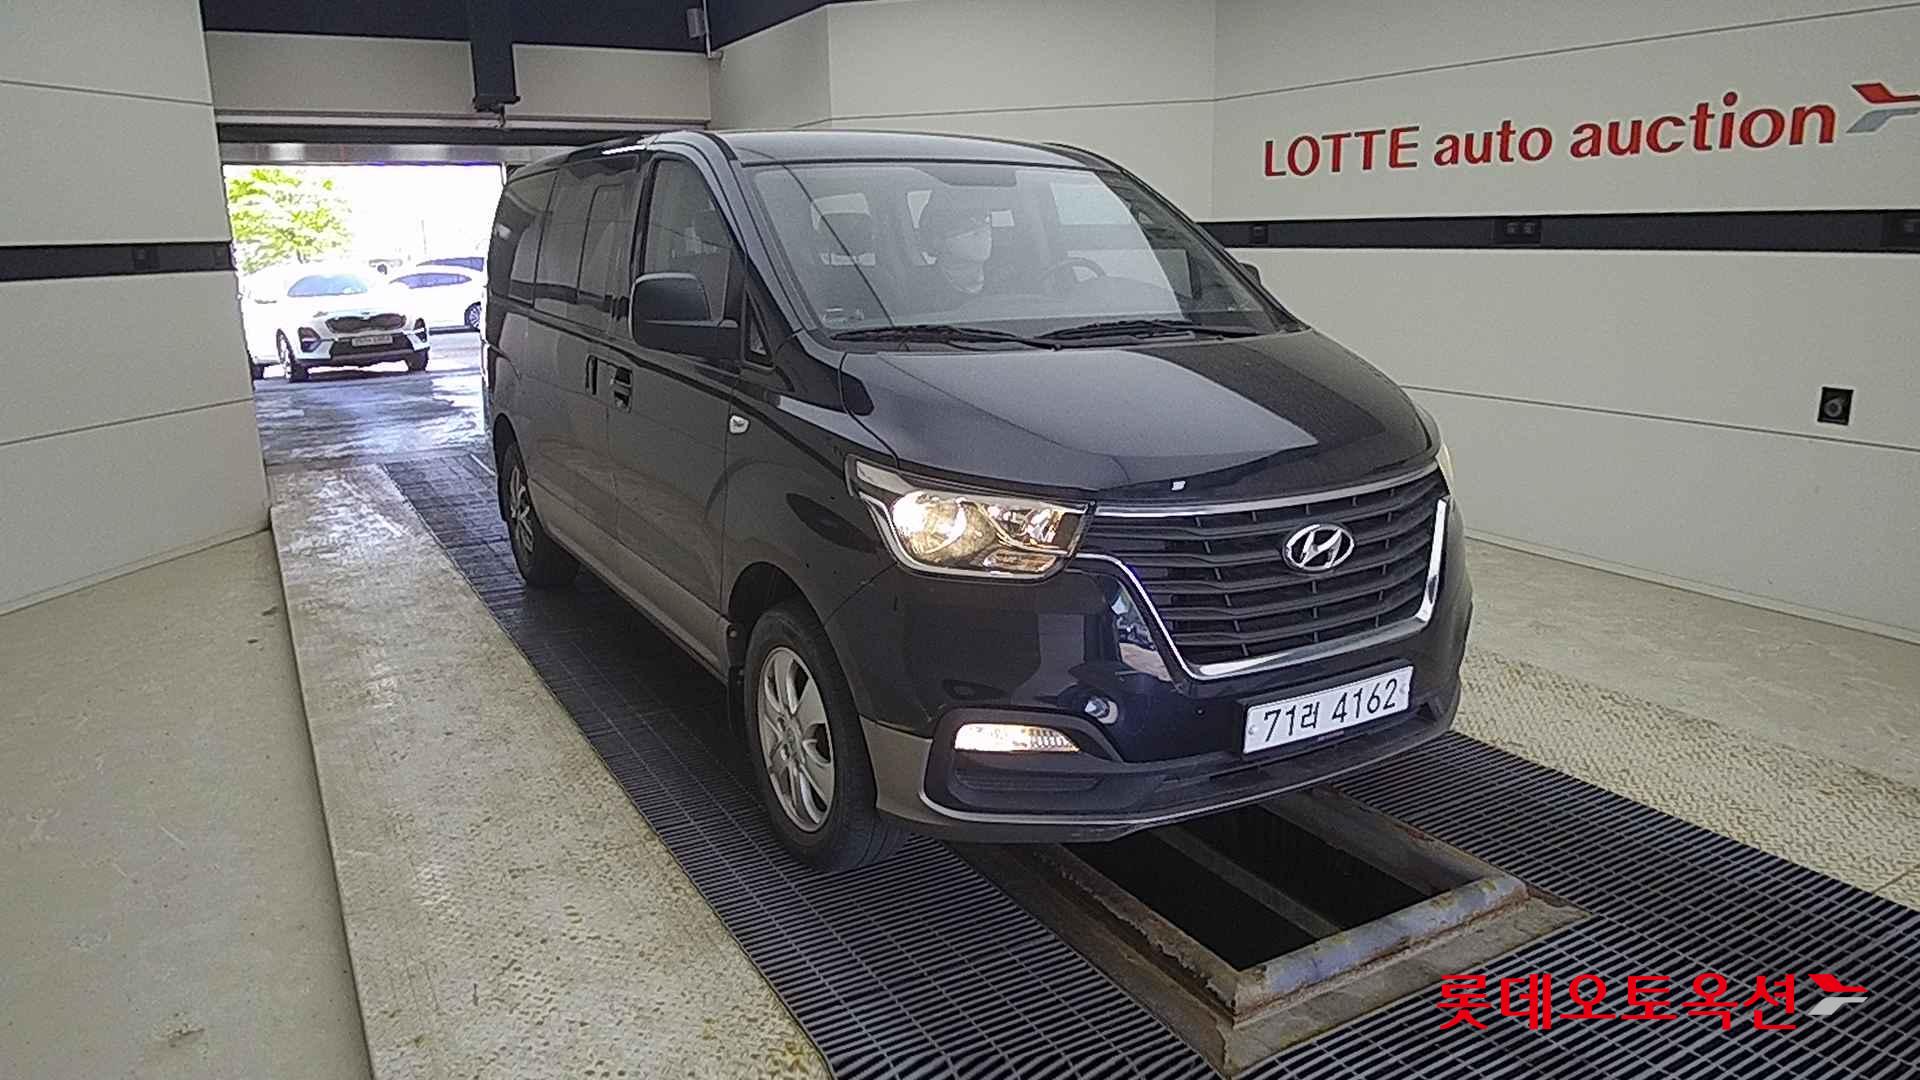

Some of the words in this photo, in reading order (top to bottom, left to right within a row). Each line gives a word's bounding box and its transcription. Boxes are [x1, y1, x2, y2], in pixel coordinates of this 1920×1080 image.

[1264, 125, 1419, 177] LOTTE
[1433, 120, 1553, 166] auto
[1569, 91, 1837, 159] auction
[1263, 701, 1321, 742] 71러
[1331, 678, 1398, 723] 4162
